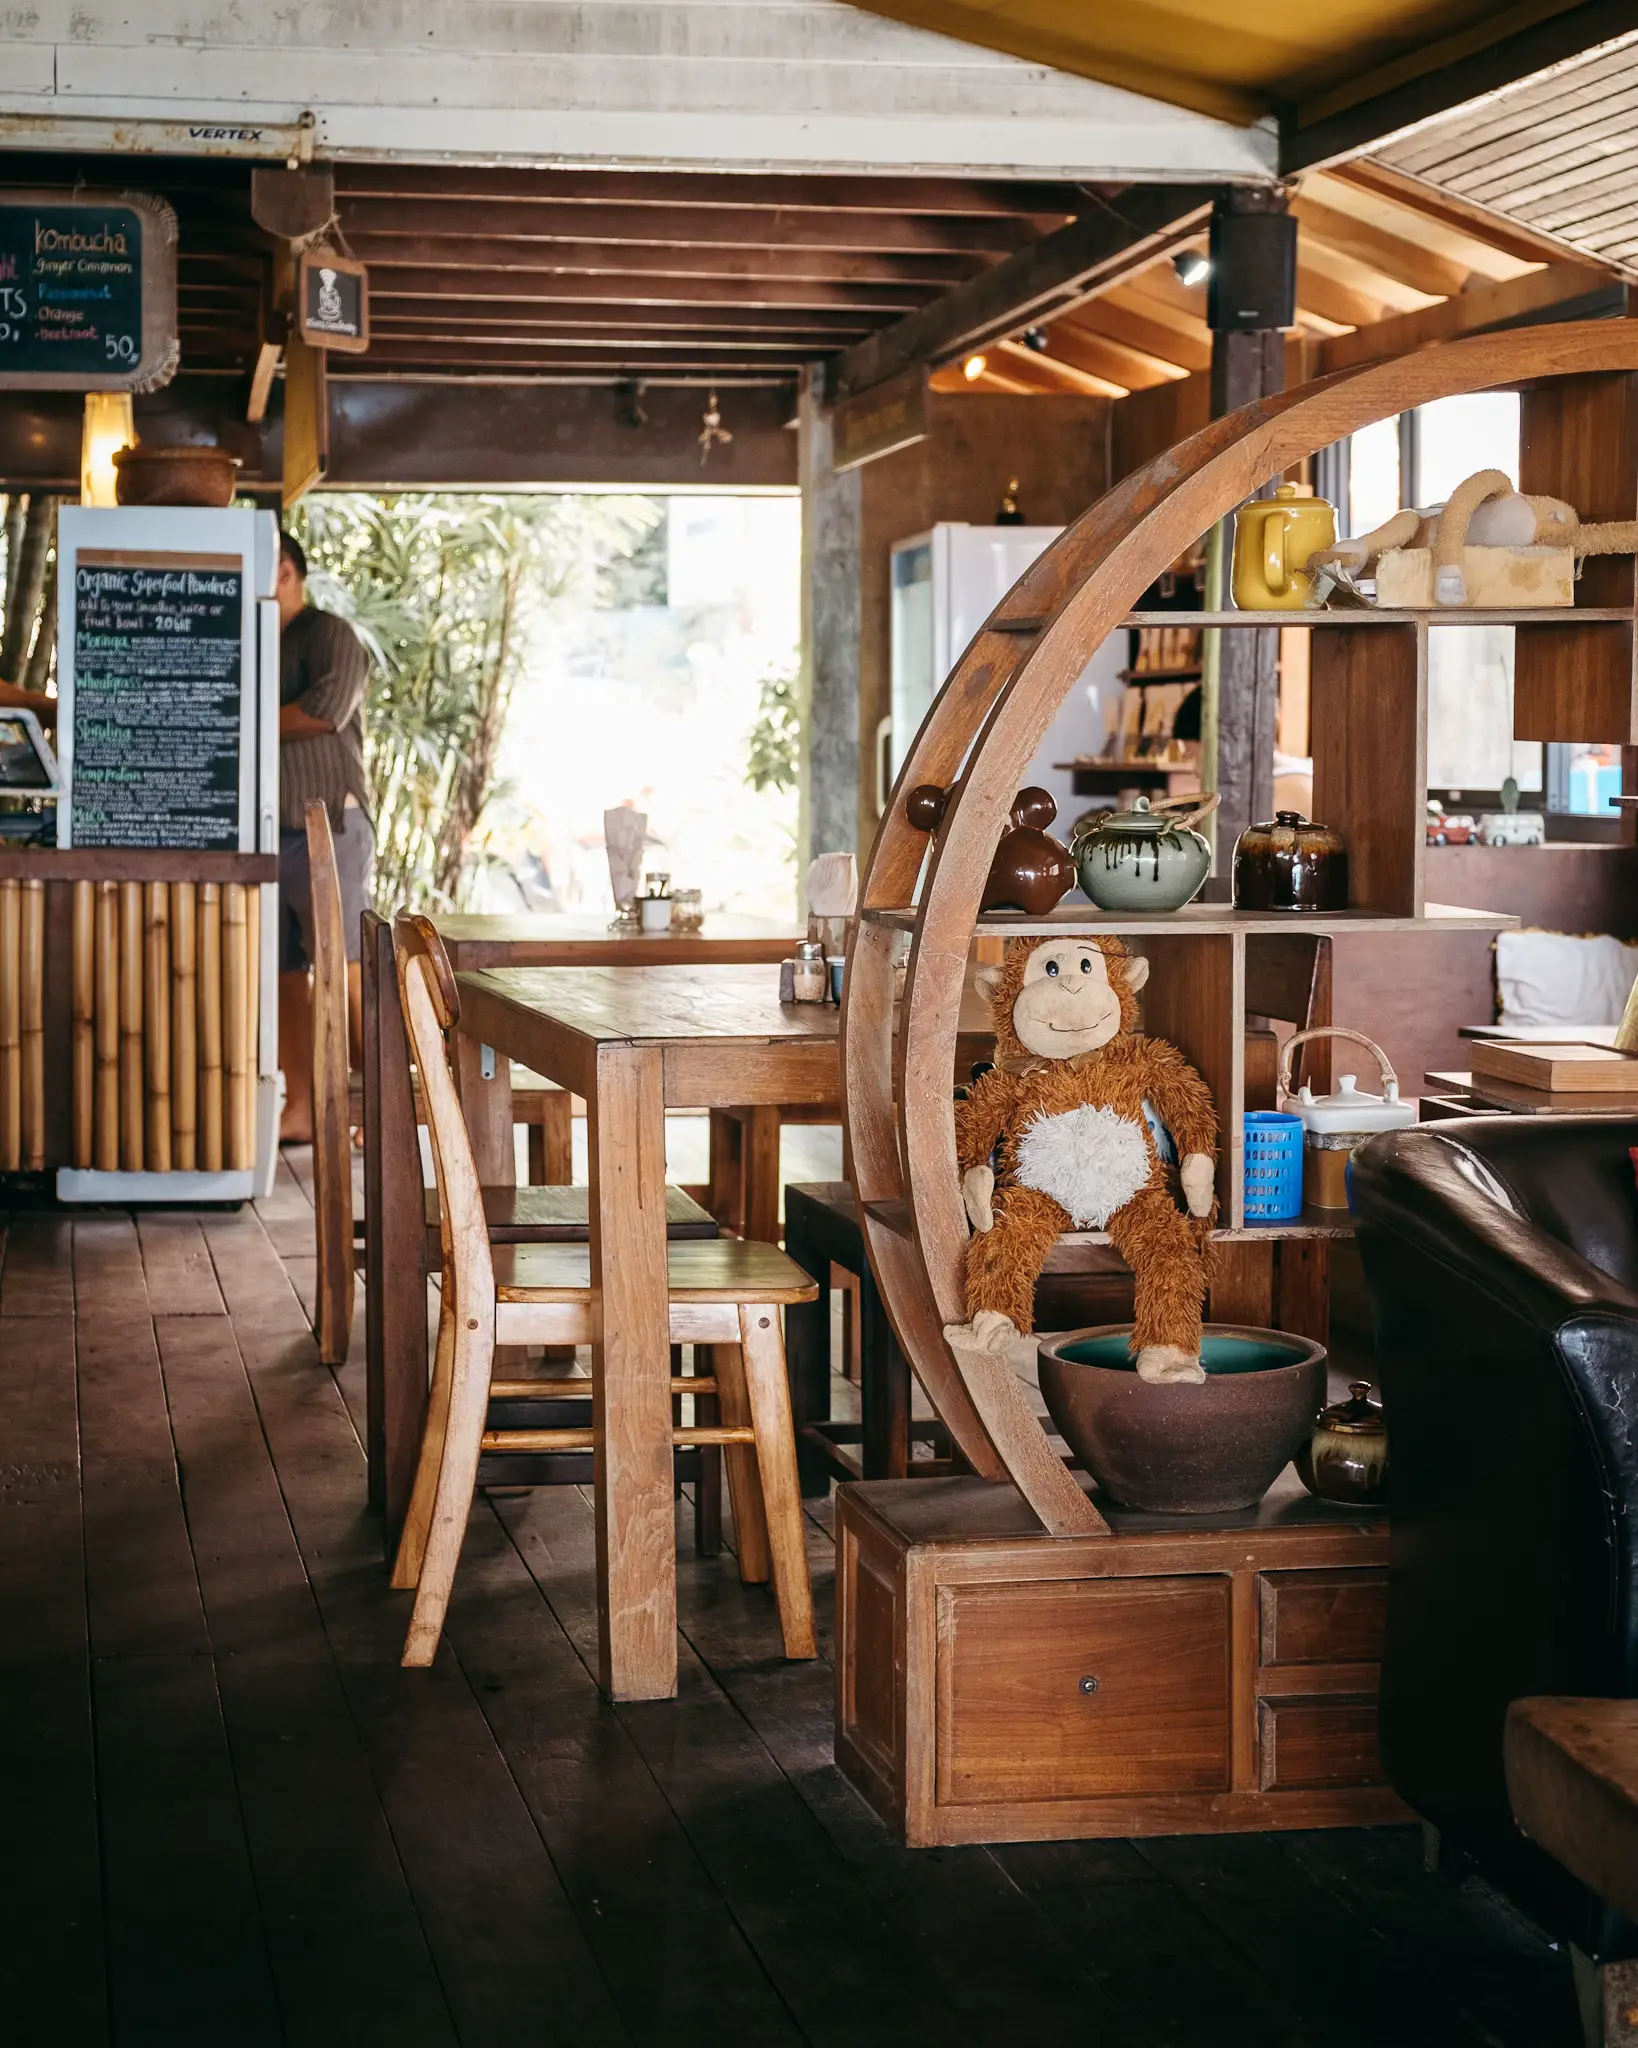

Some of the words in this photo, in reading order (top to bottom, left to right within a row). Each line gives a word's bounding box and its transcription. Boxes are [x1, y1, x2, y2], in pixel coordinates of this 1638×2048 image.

[188, 127, 262, 140] VERTEX
[76, 569, 129, 597] Organic
[131, 570, 187, 597] Superfood
[188, 572, 238, 596] Powders
